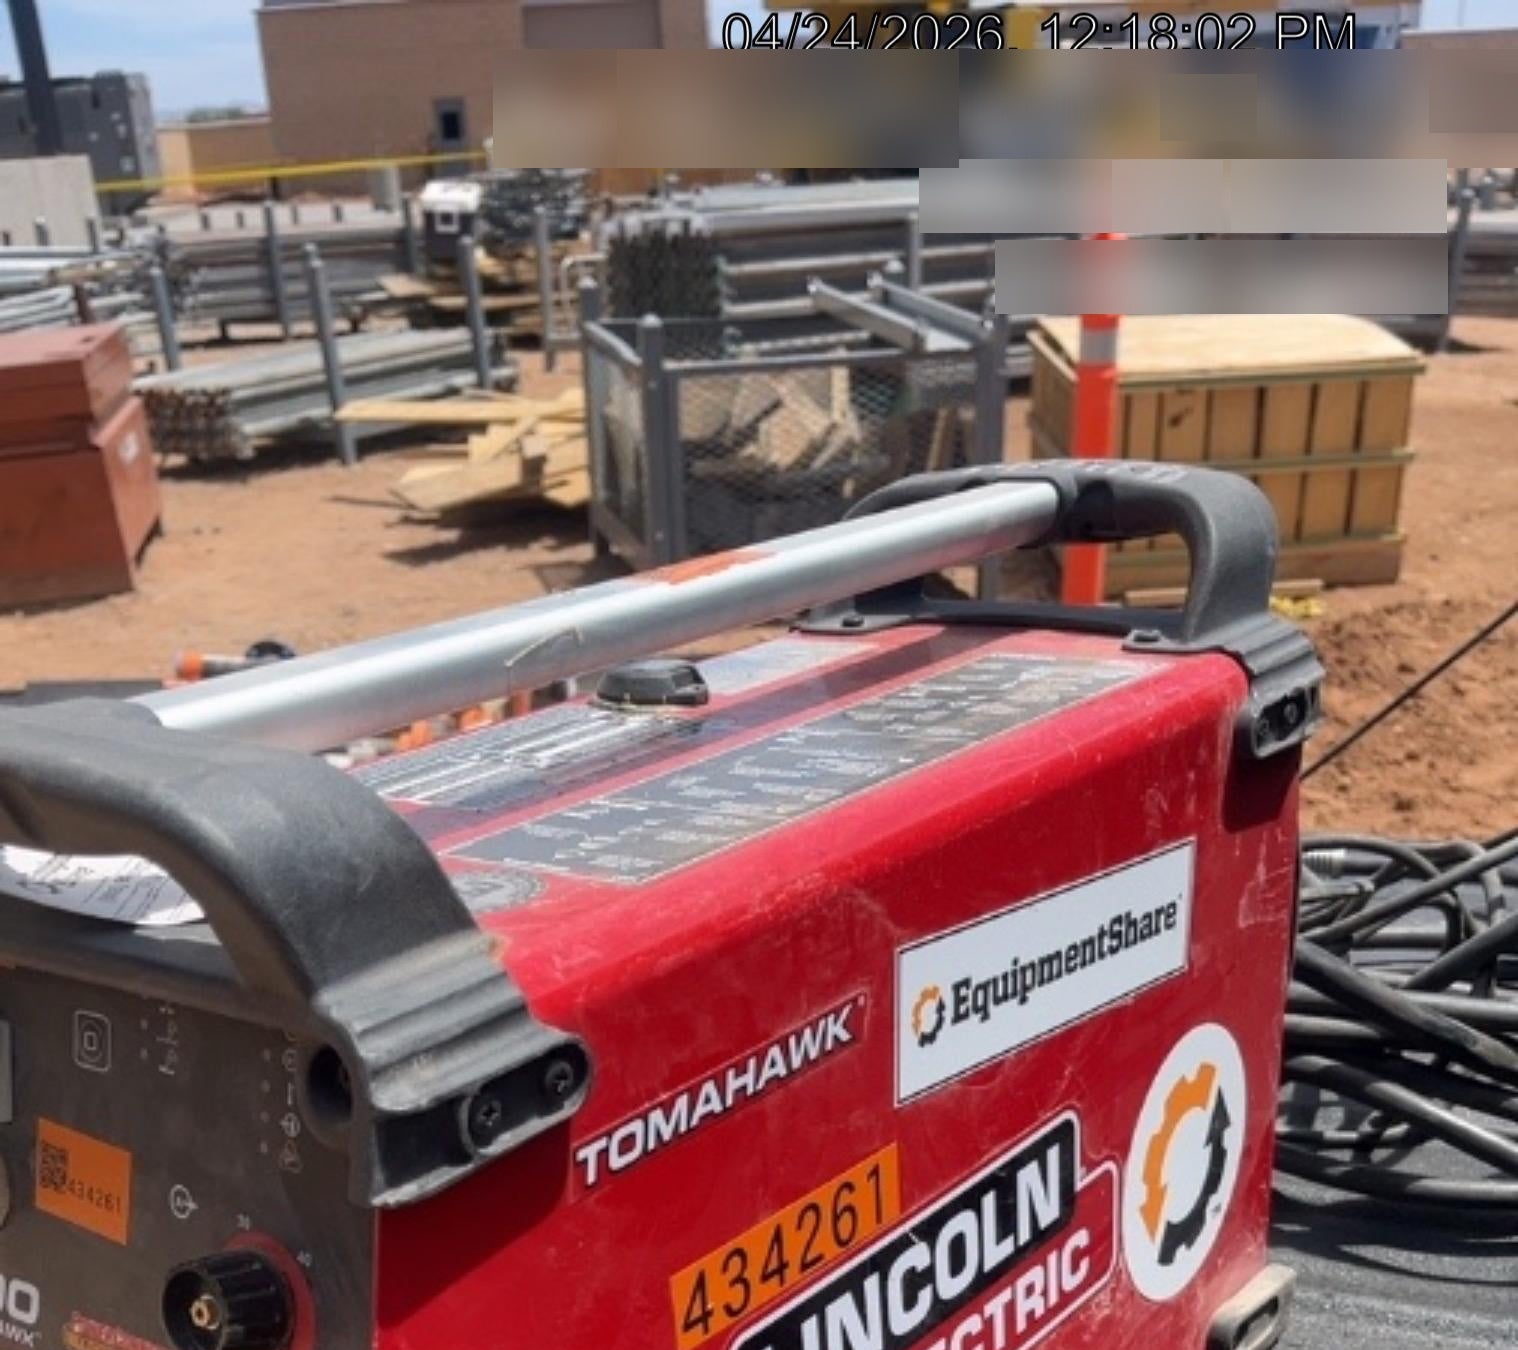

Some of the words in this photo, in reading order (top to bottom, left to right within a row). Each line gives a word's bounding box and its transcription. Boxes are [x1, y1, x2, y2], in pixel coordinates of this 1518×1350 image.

[951, 900, 1177, 1026] EquipmentShare
[576, 1004, 852, 1186] TOMAHAWK
[68, 1178, 121, 1213] 434261
[682, 1162, 886, 1337] 434261
